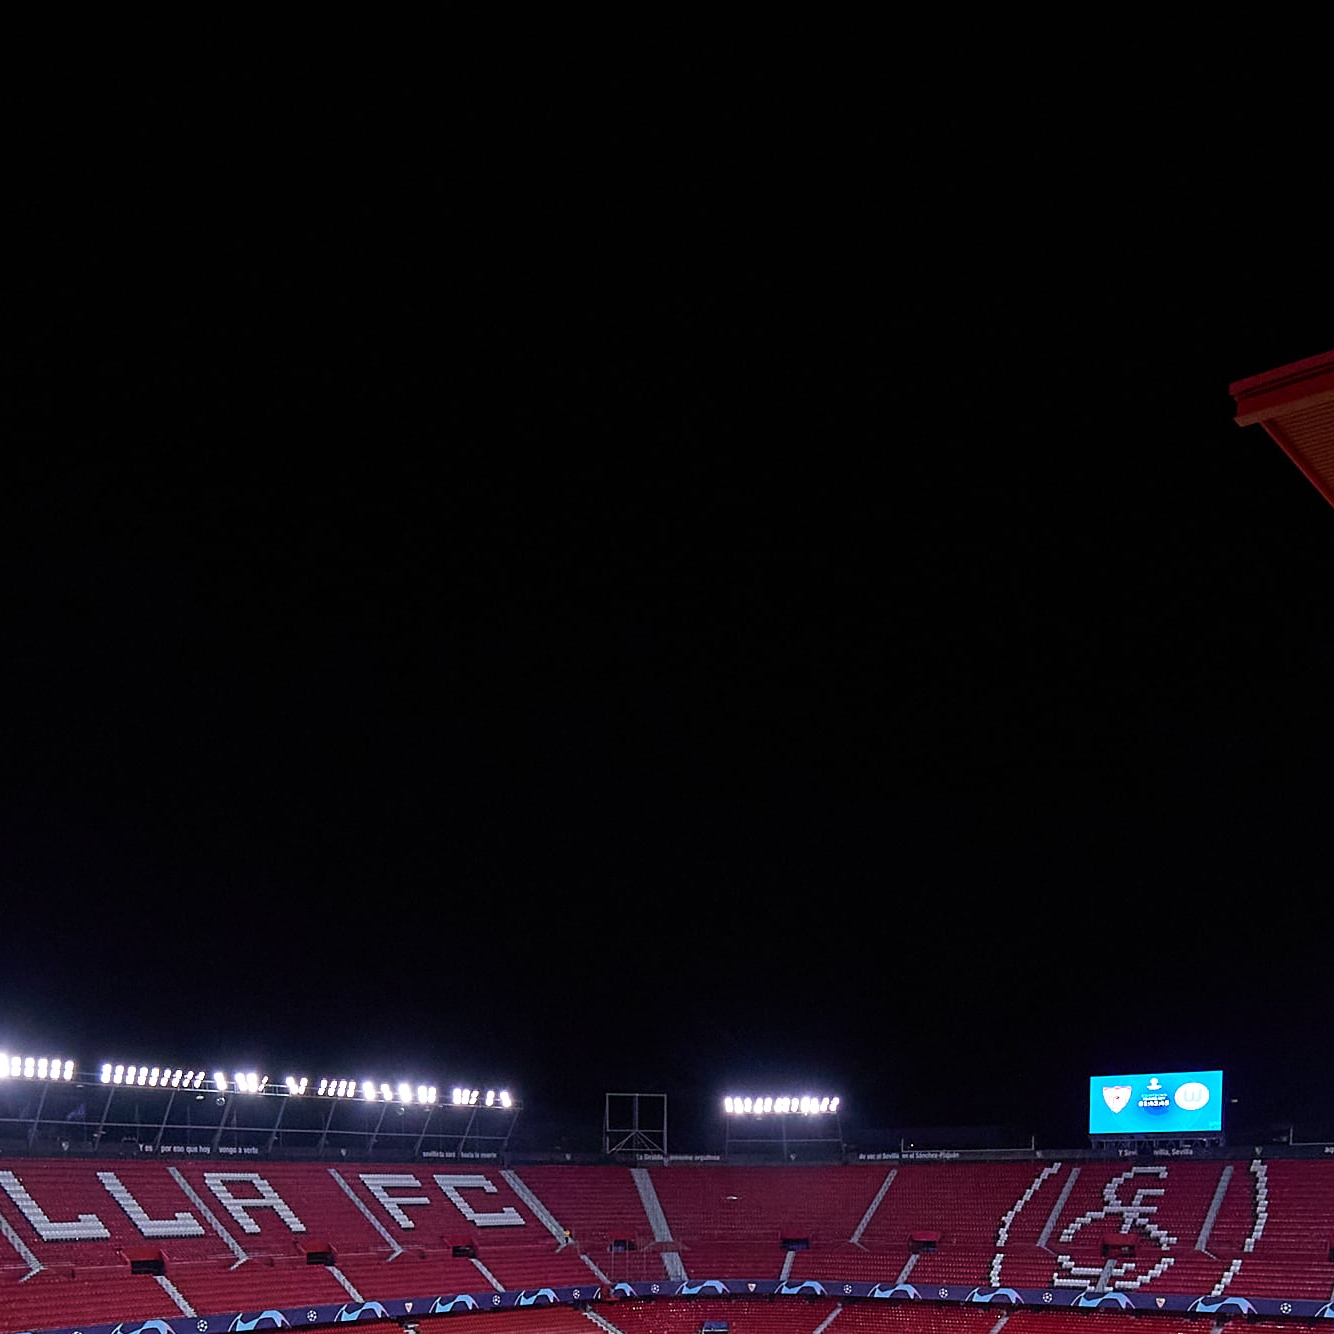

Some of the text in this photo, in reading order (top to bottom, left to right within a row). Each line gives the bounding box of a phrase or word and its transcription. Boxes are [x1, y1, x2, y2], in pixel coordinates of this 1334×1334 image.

[160, 1146, 172, 1154] por
[186, 1146, 198, 1154] que
[199, 1145, 211, 1154] hoy
[219, 1147, 237, 1155] vengo
[882, 1152, 899, 1160] Sevilla
[357, 1172, 526, 1231] FC
